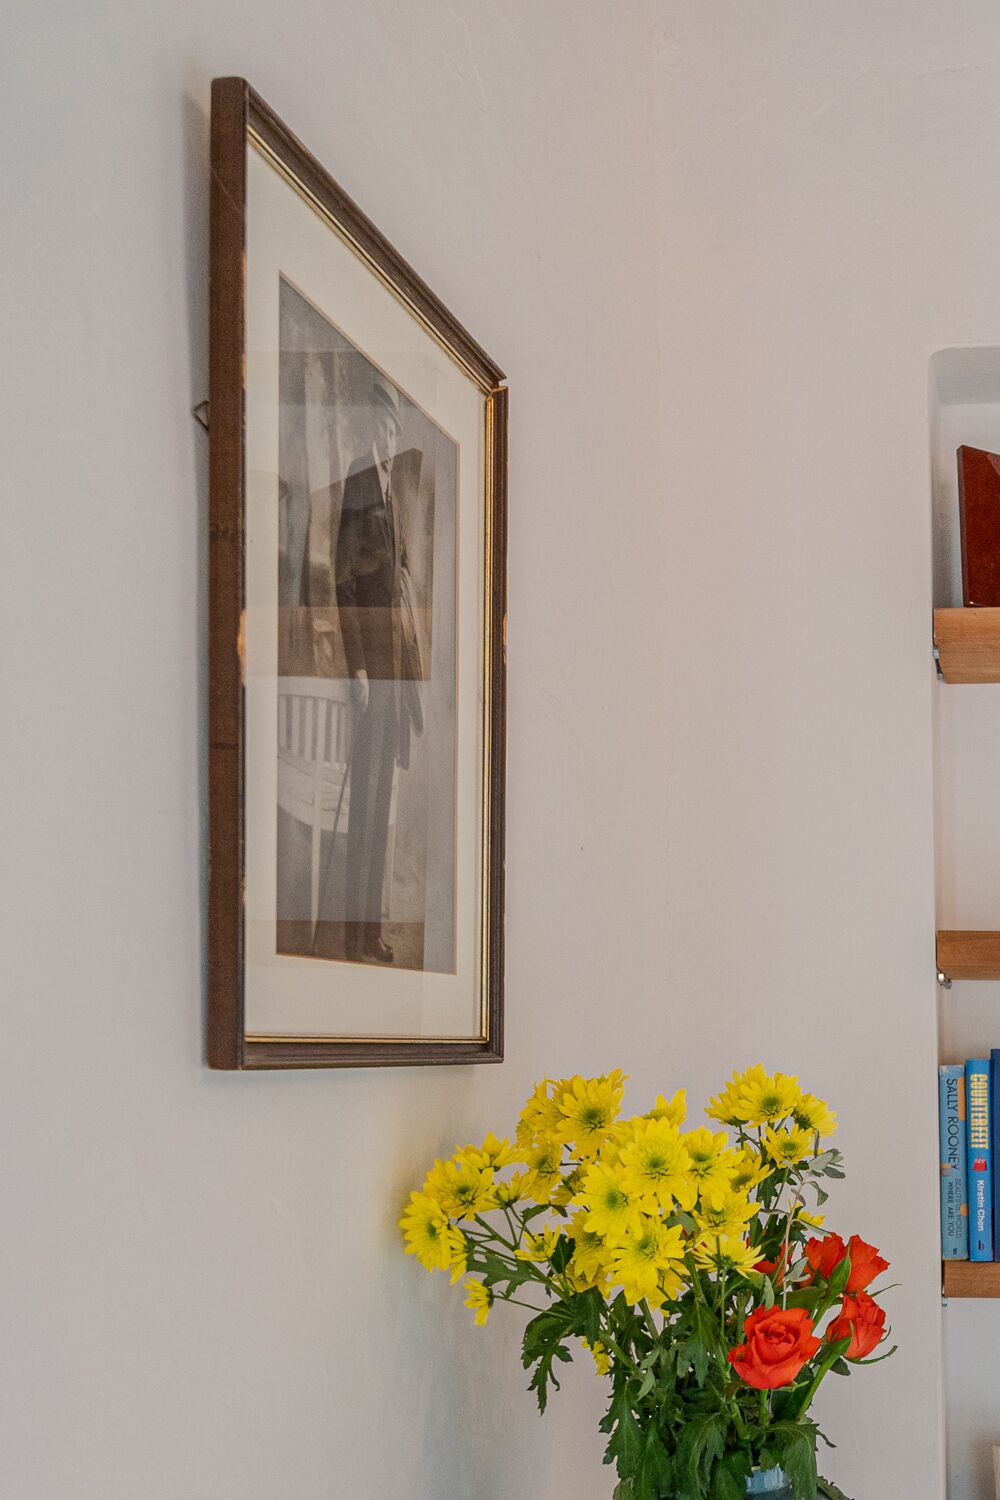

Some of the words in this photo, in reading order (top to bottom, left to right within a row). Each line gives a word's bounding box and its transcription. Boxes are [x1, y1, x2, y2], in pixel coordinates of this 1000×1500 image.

[946, 1078, 959, 1114] SALLY
[970, 1073, 989, 1150] COUNTERFEIT
[947, 1116, 960, 1170] ROONEY
[947, 1181, 955, 1204] WHERE
[977, 1179, 985, 1208] Kirstin
[947, 1206, 955, 1219] ARE
[977, 1209, 986, 1232] Chen
[947, 1221, 955, 1237] YOU
